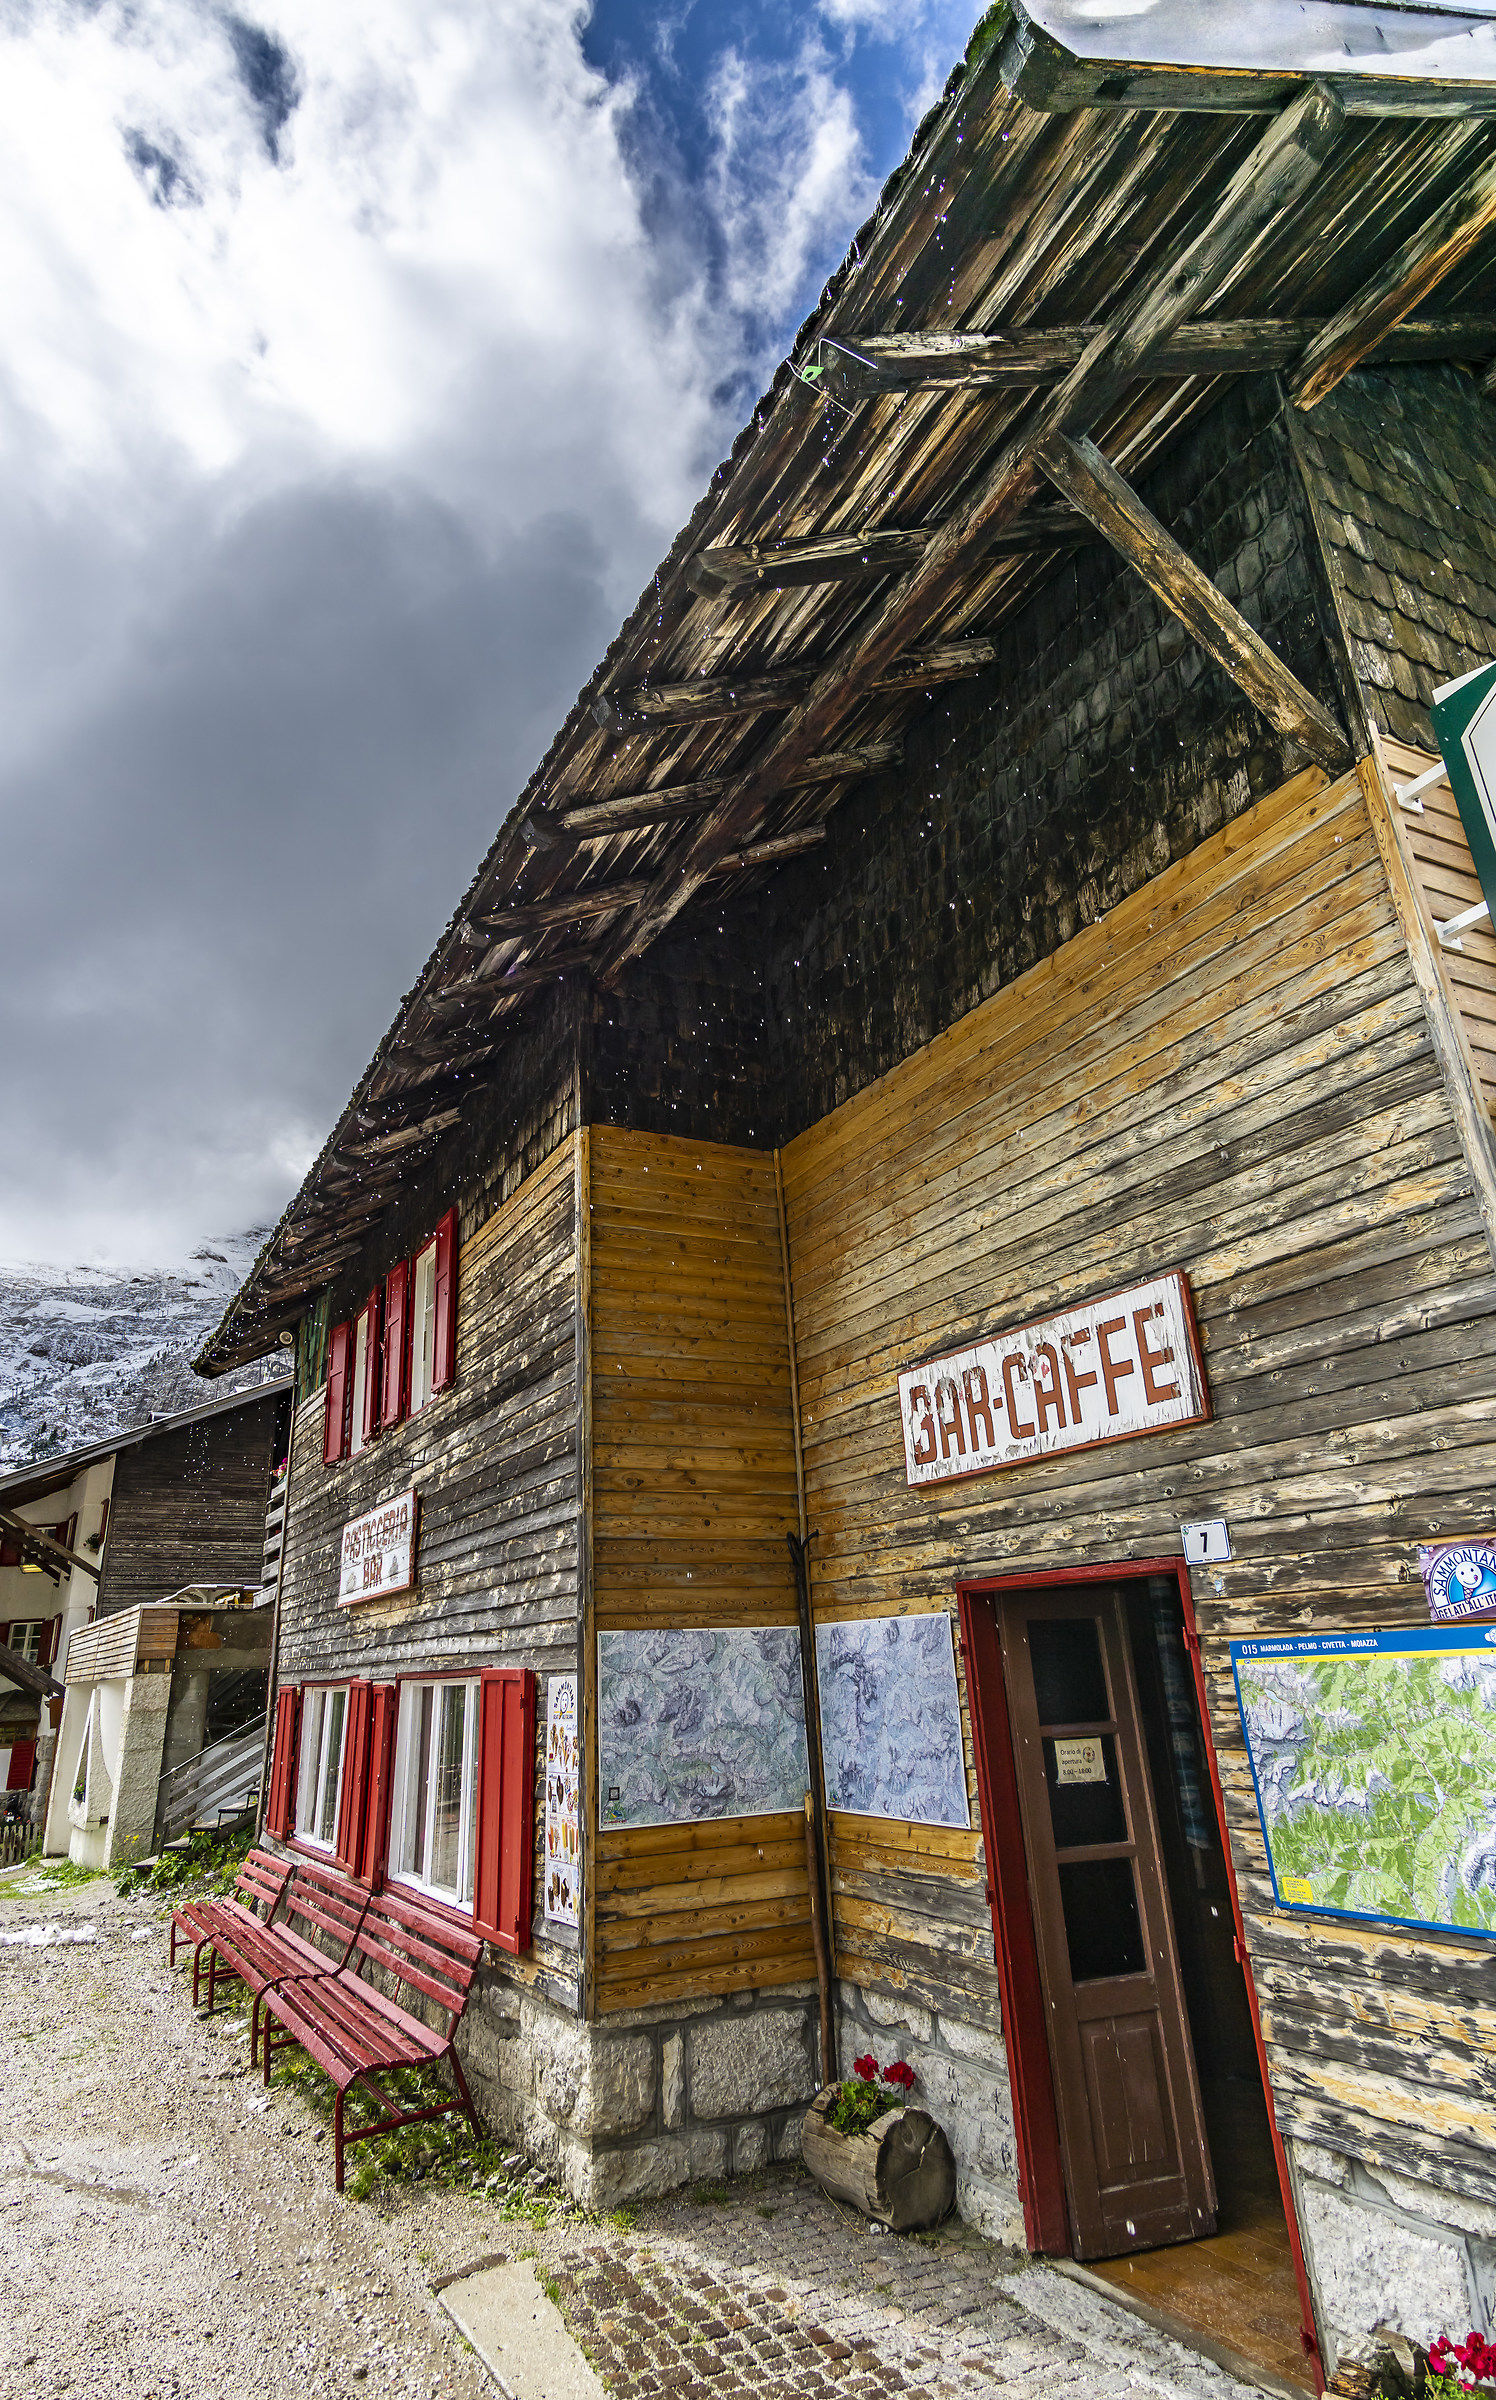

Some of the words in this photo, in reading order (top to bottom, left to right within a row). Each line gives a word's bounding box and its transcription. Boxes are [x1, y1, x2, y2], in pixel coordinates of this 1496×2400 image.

[910, 1303, 1182, 1465] BAR-CAFFE
[1199, 1532, 1208, 1553] 7
[362, 1552, 383, 1590] BAR
[1439, 1602, 1468, 1619] GELATI
[1242, 1644, 1258, 1655] 015
[1260, 1643, 1294, 1652] MARMOLADA
[1298, 1642, 1317, 1651] PELMO
[1322, 1640, 1346, 1649] CIVETTA
[1351, 1639, 1379, 1648] MOIAZZA
